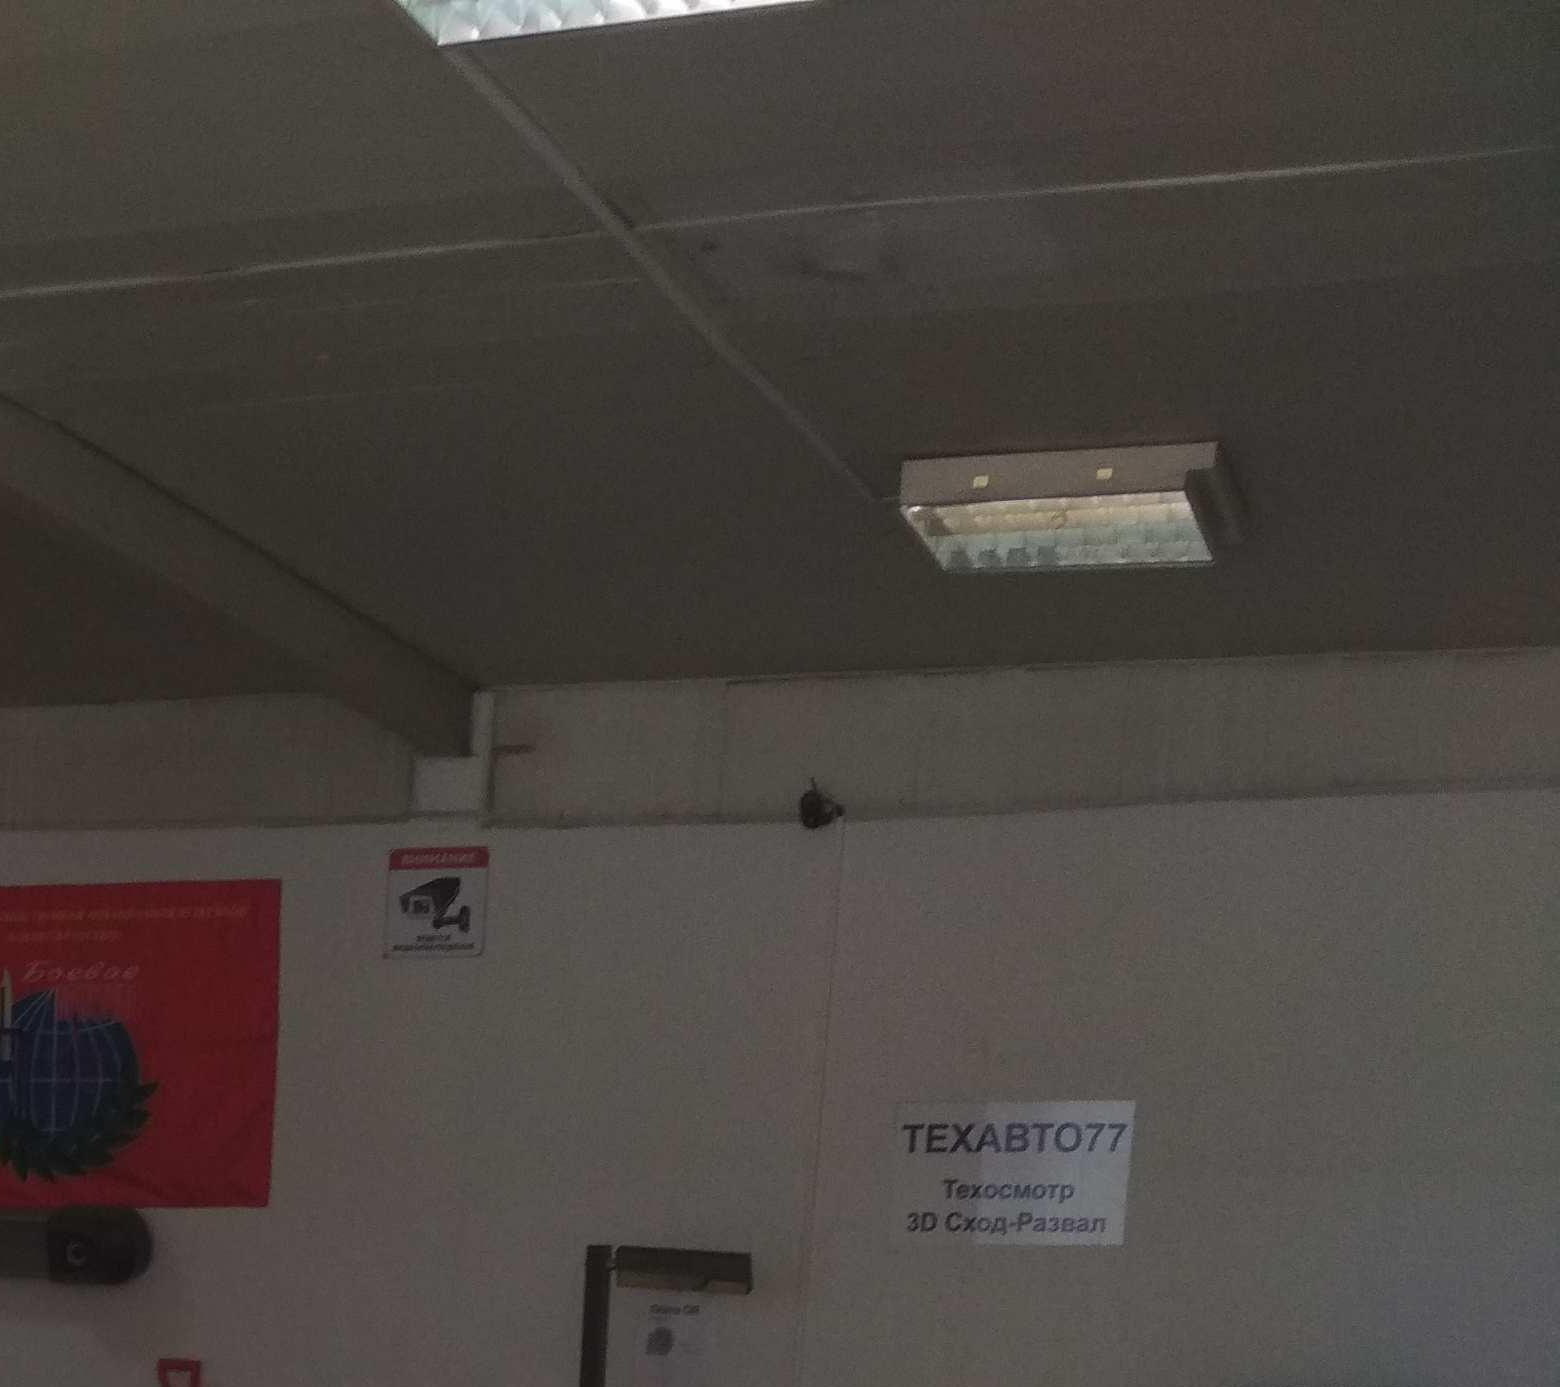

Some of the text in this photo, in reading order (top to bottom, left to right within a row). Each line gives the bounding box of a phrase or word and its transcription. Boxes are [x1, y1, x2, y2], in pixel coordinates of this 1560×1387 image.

[902, 1122, 1127, 1153] ТЕХАВТО77
[943, 1178, 1075, 1203] Техосмотр
[907, 1211, 1107, 1235] 3D Сход-Развал
